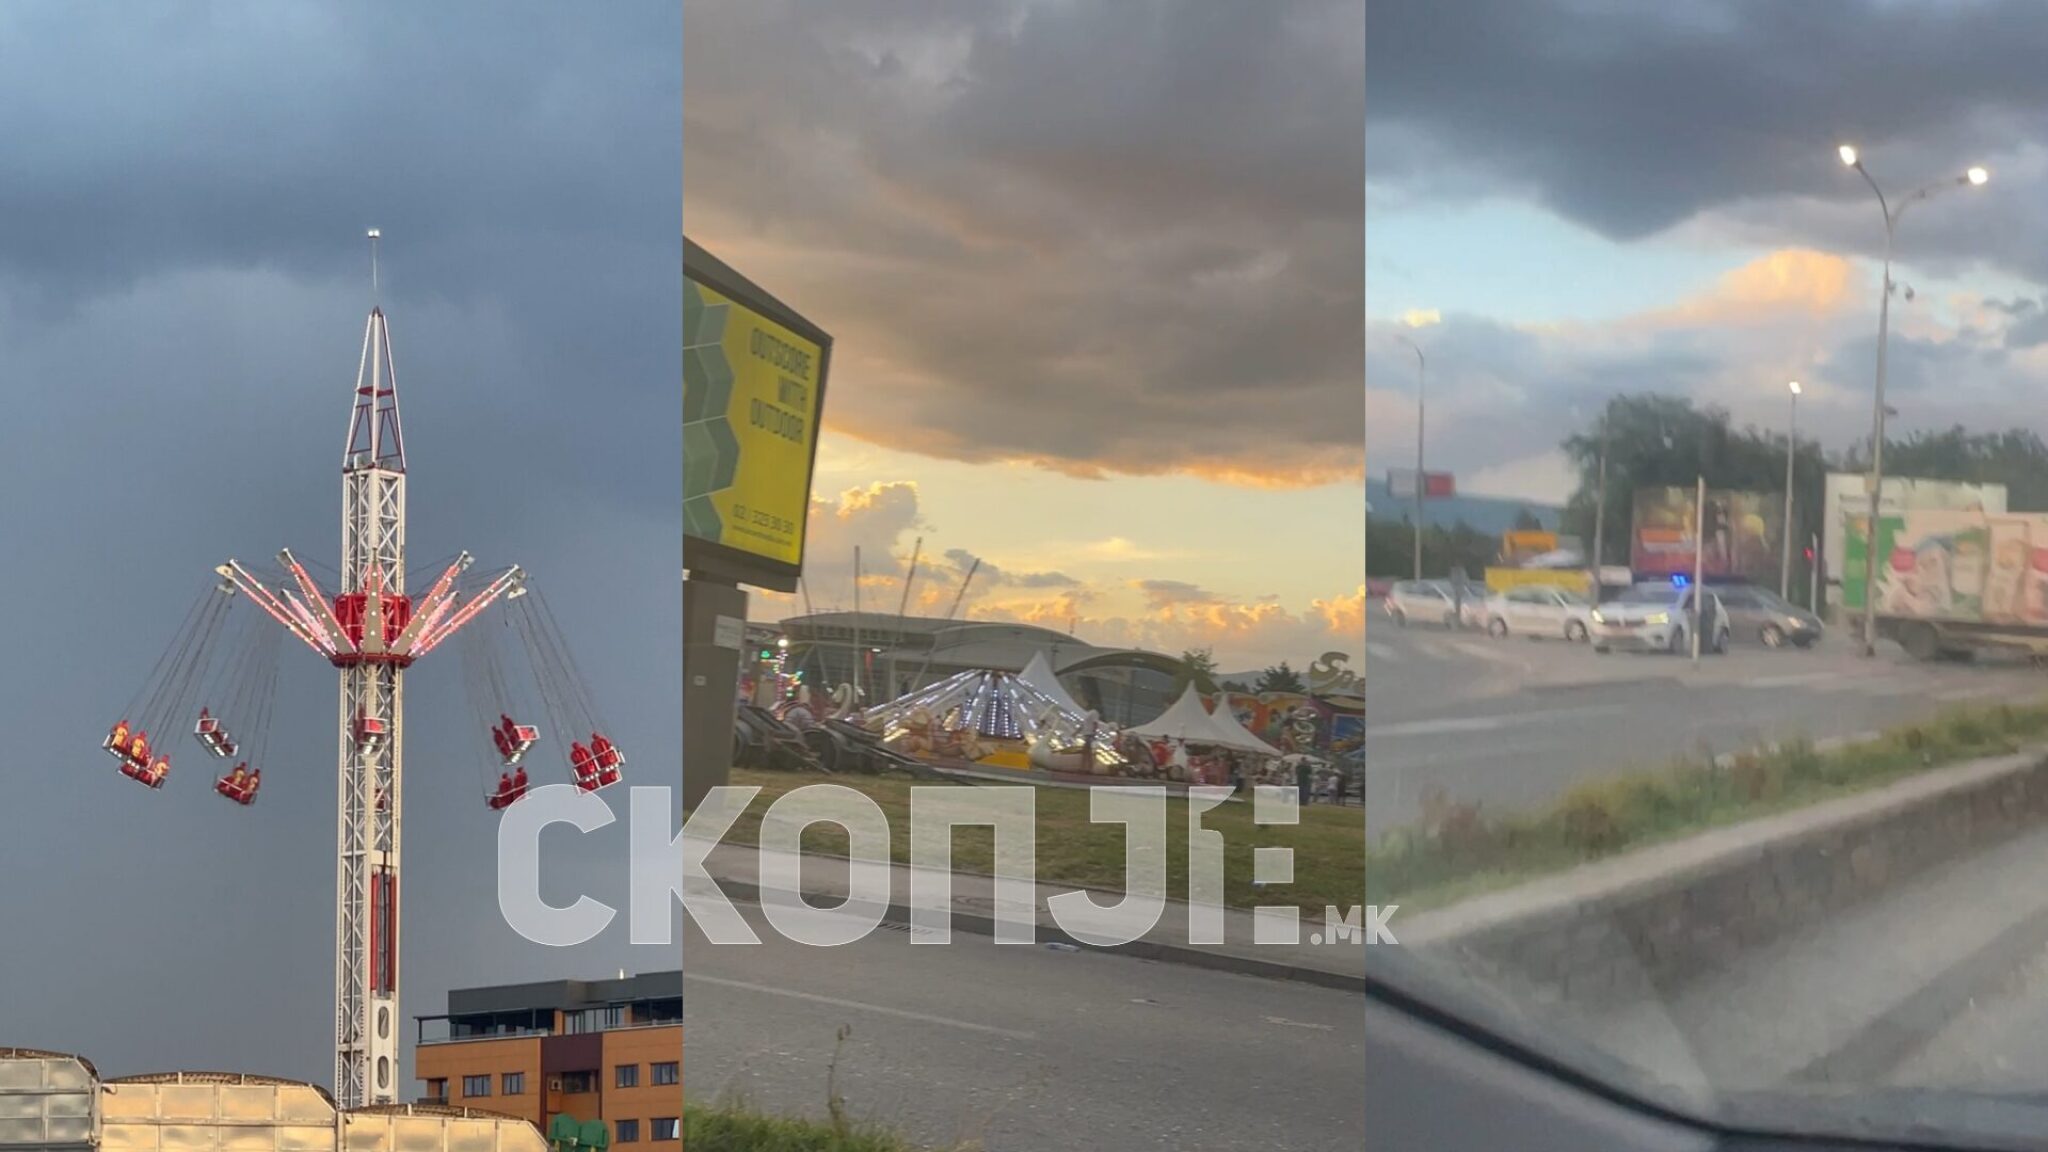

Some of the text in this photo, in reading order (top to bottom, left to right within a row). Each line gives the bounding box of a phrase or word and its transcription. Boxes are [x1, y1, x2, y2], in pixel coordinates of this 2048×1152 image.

[751, 327, 810, 380] OUTSCORE
[778, 376, 808, 413] WITH
[751, 397, 804, 445] OUTDOOR
